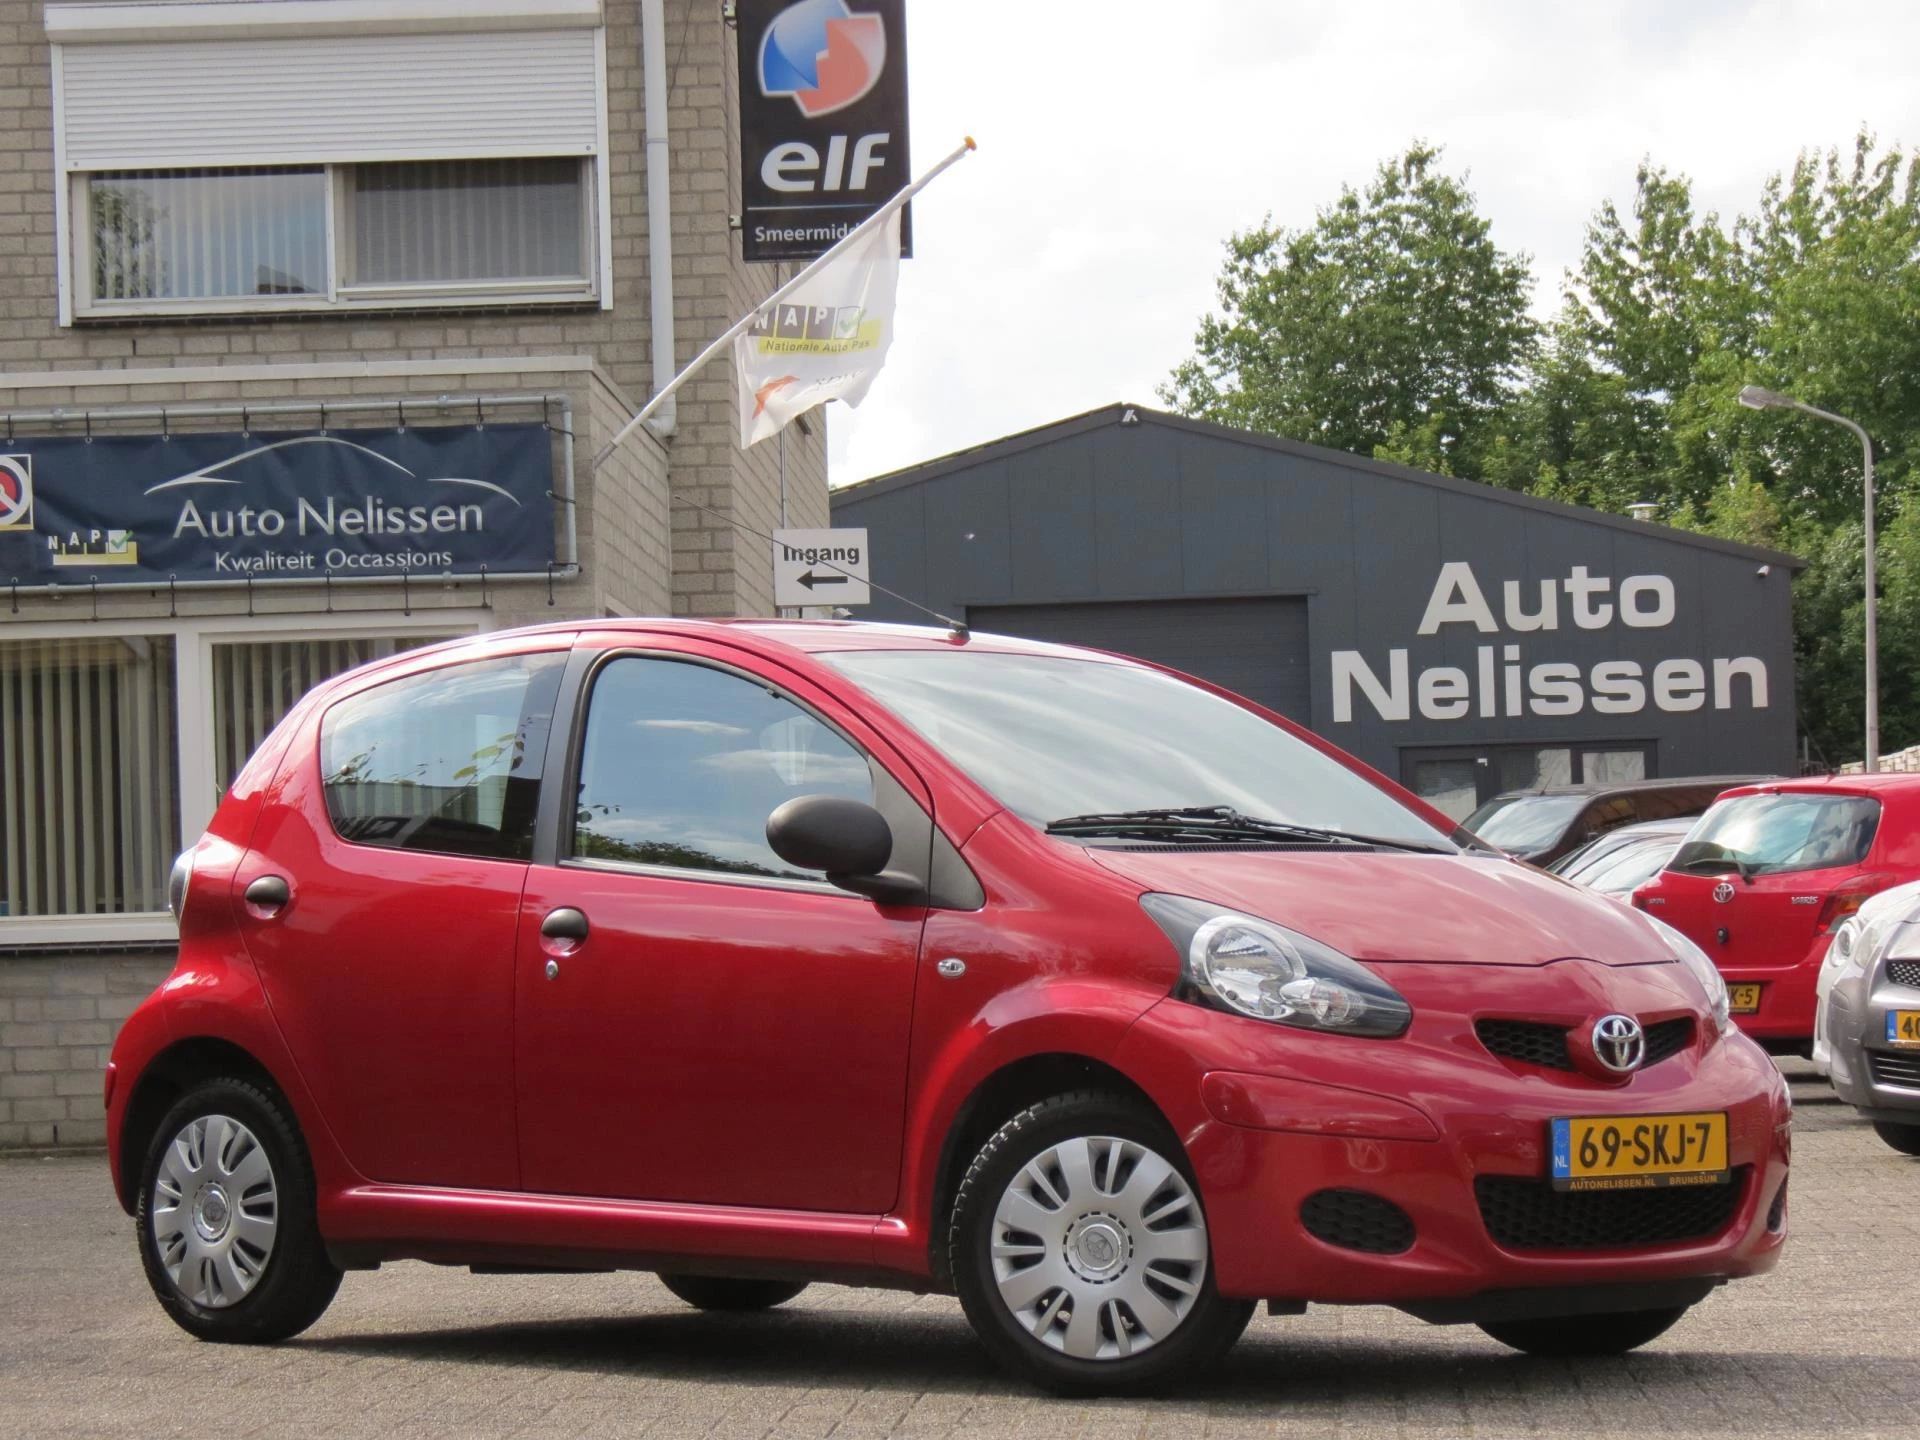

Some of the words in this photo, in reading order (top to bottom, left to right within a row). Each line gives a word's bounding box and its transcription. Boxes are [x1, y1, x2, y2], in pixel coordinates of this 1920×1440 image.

[761, 132, 890, 192] elf
[766, 340, 820, 353] Nationale
[822, 341, 848, 353] Auto
[851, 339, 870, 350] Pas
[172, 499, 285, 539] Auto
[298, 495, 483, 536] Nelissen
[215, 550, 315, 572] Kwaliteit
[325, 548, 453, 569] Occassions
[783, 544, 860, 566] Ingang
[1417, 561, 1676, 635] Auto
[1331, 644, 1769, 723] Nelissen
[1554, 1155, 1568, 1168] NL
[1579, 1122, 1711, 1169] 69-SKJ-7
[1570, 1176, 1656, 1192] AUTONELISSEN.NL
[1669, 1174, 1717, 1185] BRUNSSUM
